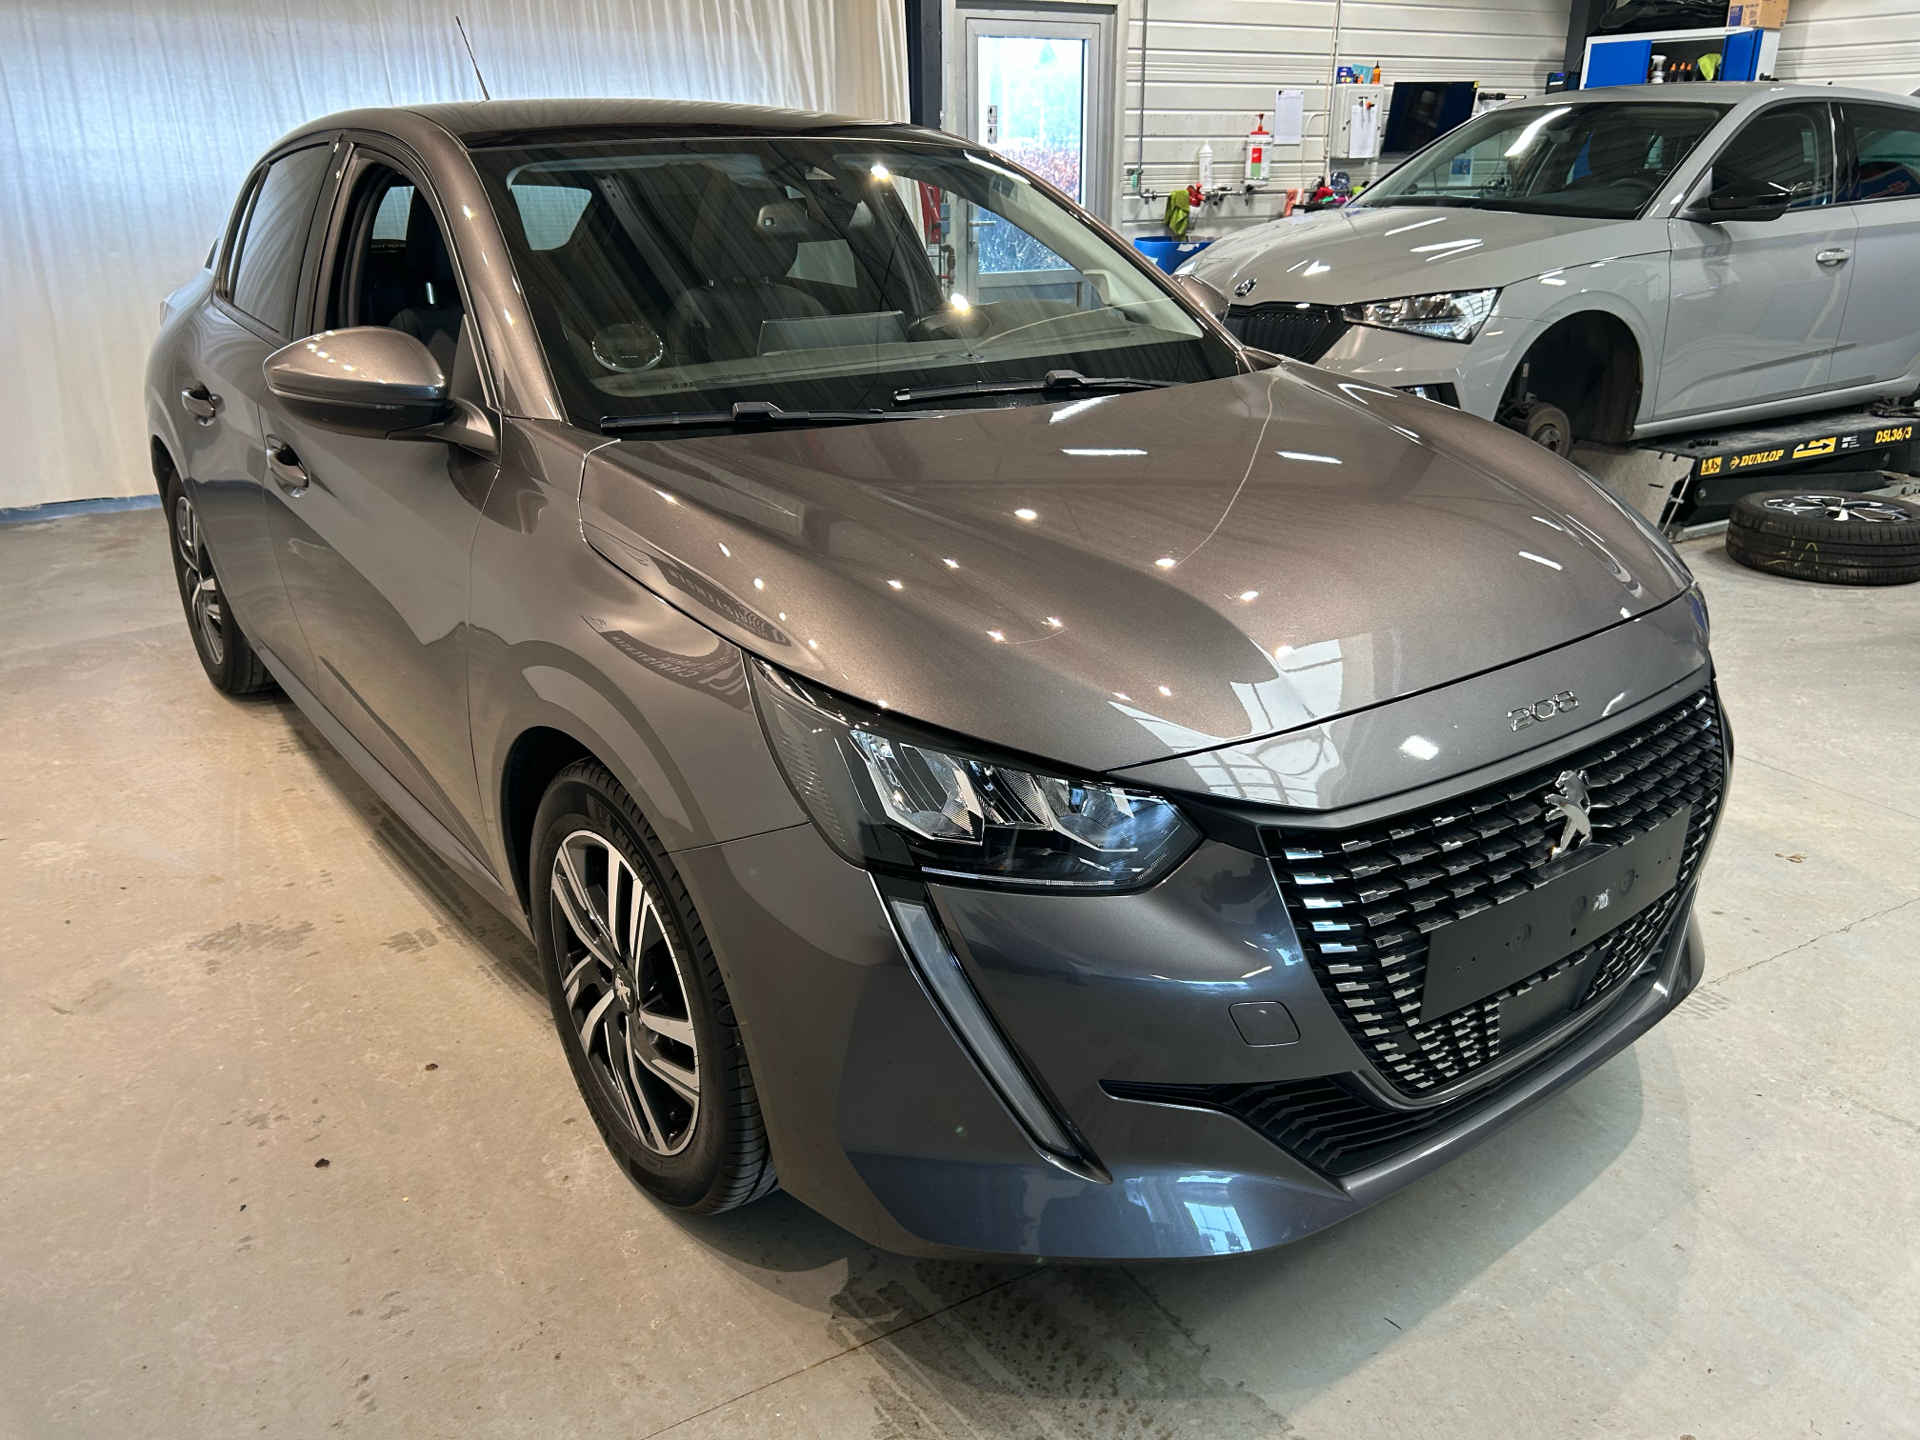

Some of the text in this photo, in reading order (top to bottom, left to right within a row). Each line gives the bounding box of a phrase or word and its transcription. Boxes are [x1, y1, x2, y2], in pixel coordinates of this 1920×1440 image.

[1875, 426, 1912, 444] DSL36/3
[1738, 449, 1785, 467] DUNLOP
[1507, 690, 1579, 732] 208
[614, 829, 680, 943] MICHELIN
